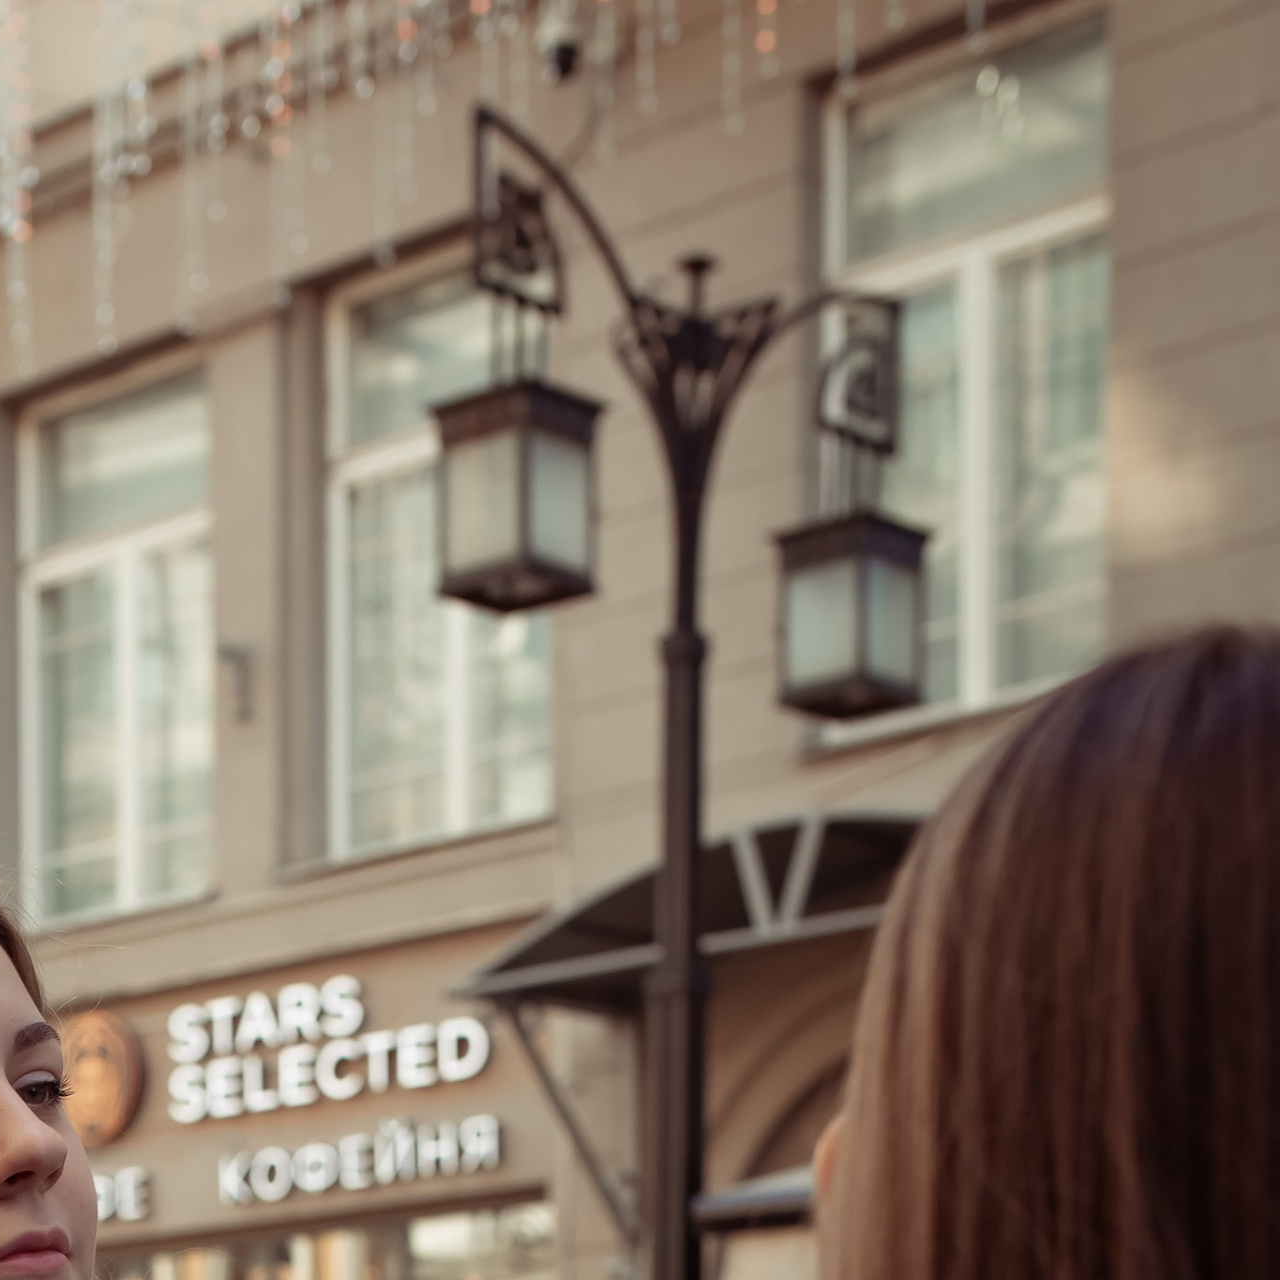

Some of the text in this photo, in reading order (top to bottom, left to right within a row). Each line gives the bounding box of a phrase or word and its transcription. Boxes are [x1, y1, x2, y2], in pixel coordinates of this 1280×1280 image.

[167, 973, 364, 1064] STARS
[167, 1016, 490, 1124] SELECTED
[219, 1113, 500, 1204] КОФЕЙНЯ
